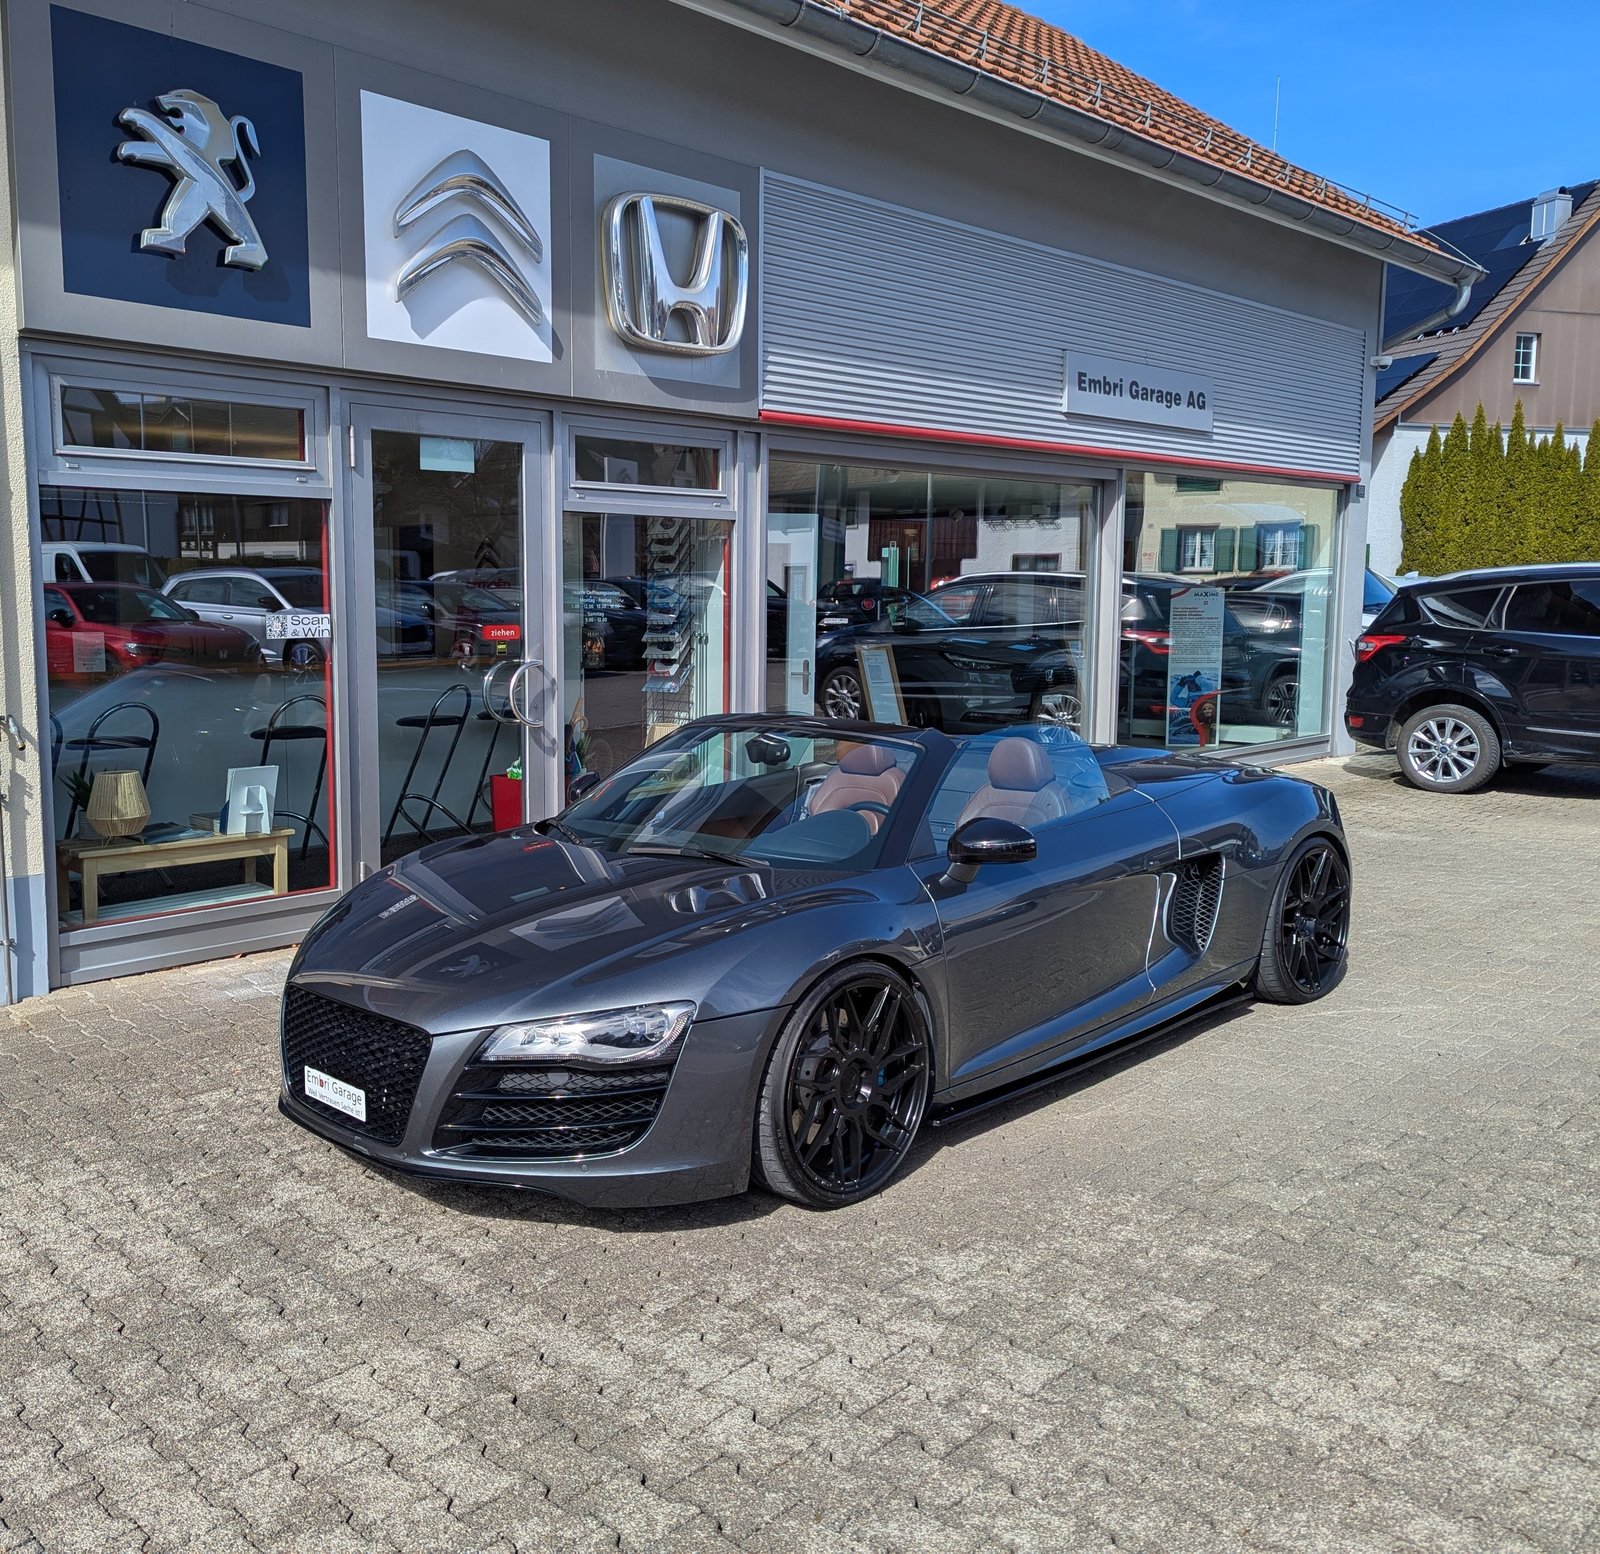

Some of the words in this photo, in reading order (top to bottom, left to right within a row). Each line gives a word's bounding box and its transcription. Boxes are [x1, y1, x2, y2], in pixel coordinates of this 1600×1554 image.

[1077, 371, 1124, 397] Embri
[1128, 380, 1182, 409] Garage
[1186, 390, 1206, 410] AG
[291, 615, 330, 626] Scan
[291, 628, 300, 637] &
[302, 626, 331, 637] Win
[490, 629, 515, 637] ziehen
[307, 1070, 330, 1091] Embri
[332, 1081, 362, 1106] Garage
